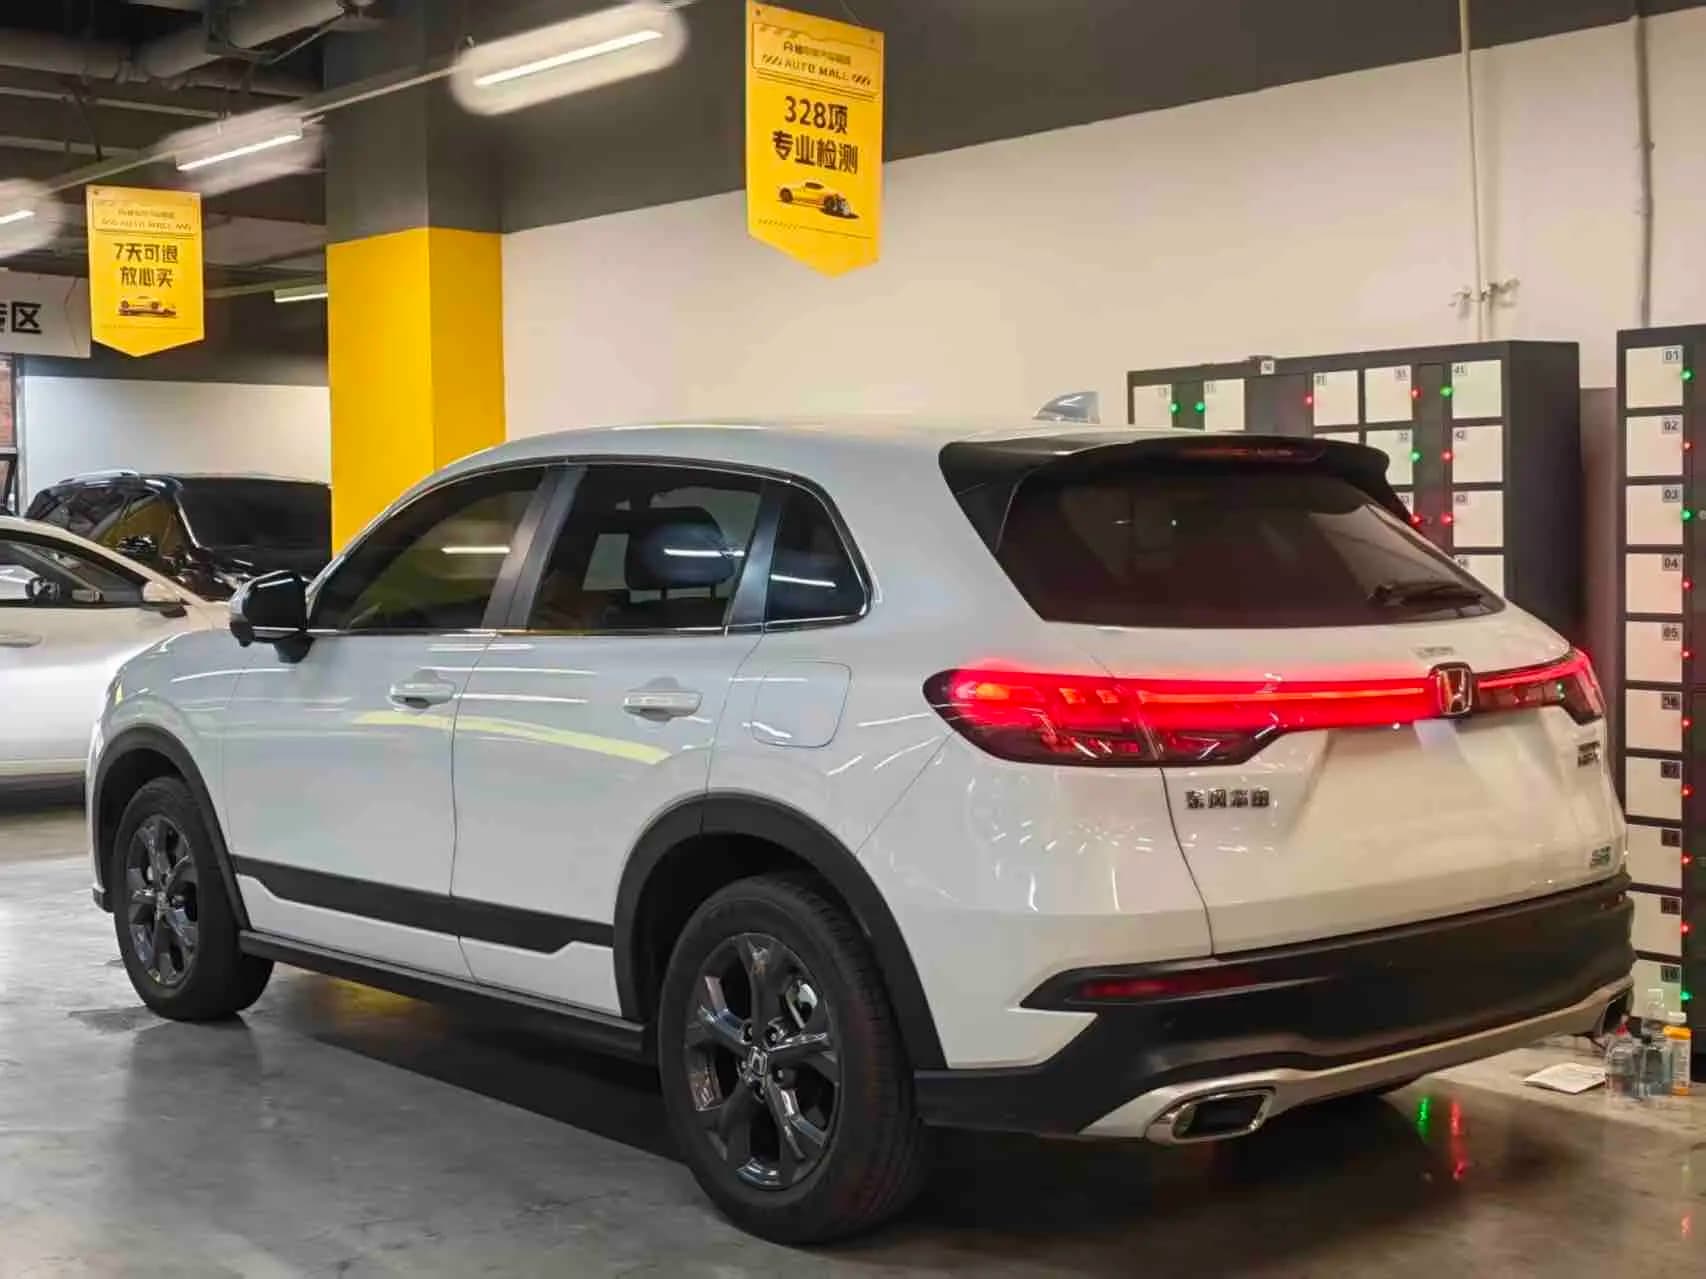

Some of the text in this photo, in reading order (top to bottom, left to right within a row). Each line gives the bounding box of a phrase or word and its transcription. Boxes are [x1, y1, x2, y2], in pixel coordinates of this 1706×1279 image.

[784, 95, 849, 135] 328项
[771, 129, 860, 175] 专业检测
[113, 242, 179, 265] 7天可退
[119, 265, 175, 289] 放心买
